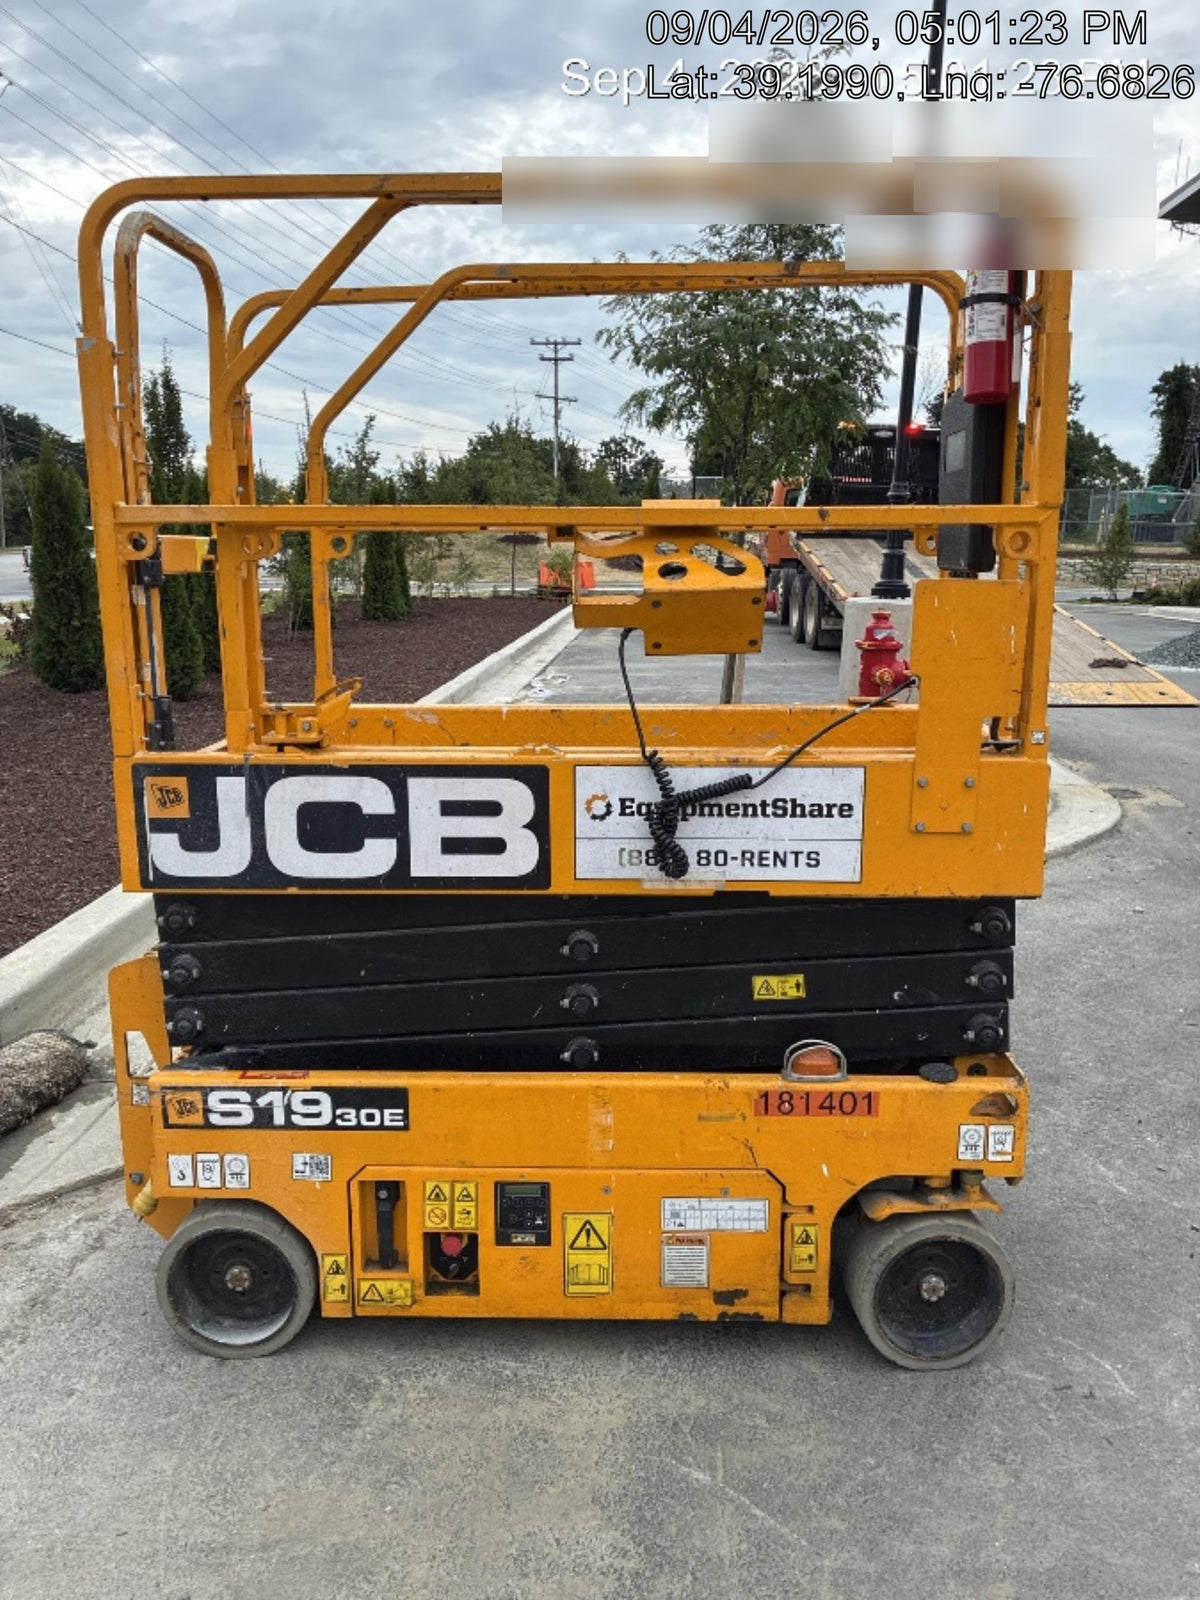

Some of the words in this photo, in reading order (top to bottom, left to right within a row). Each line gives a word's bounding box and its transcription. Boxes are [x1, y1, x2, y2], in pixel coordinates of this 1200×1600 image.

[617, 797, 854, 821] EqpmentShare
[149, 775, 540, 878] JCB
[696, 849, 821, 868] 80-RENTS
[759, 1090, 874, 1116] 181401
